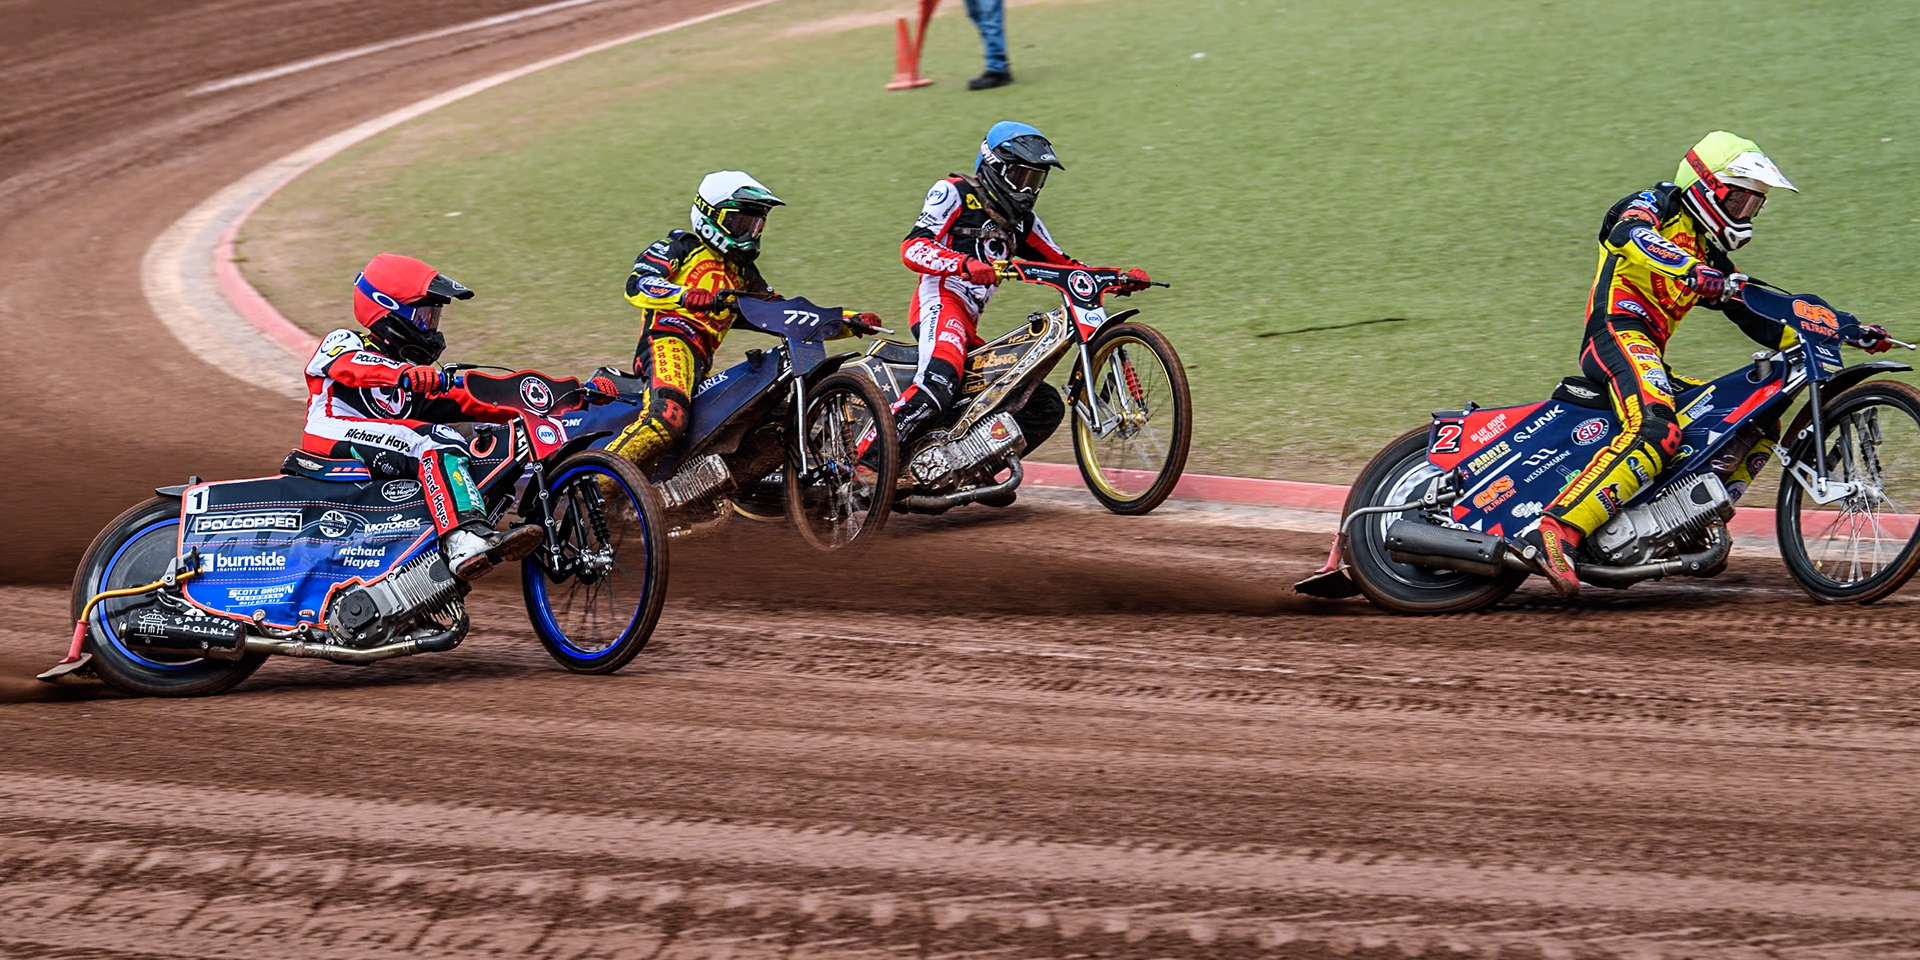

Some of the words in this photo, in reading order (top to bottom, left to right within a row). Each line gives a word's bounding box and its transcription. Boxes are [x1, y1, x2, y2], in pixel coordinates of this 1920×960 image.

[783, 310, 820, 326] 777
[1470, 426, 1488, 442] BLUE
[1487, 413, 1507, 429] DOOR
[1525, 404, 1564, 434] LINK
[1433, 425, 1462, 450] 2
[1478, 422, 1507, 444] PROJECT
[1581, 424, 1598, 439] STS
[1467, 441, 1509, 472] PARRYS
[1524, 450, 1572, 483] WESSEXMARINE
[1558, 452, 1617, 507] BRUMMIES
[422, 456, 440, 495] Ricard
[432, 493, 449, 528] Hayes
[194, 492, 203, 510] 1
[1483, 488, 1517, 514] FILTRATION
[200, 517, 296, 530] POLCOPPER
[364, 518, 421, 532] MOTOREX
[216, 551, 286, 567] burnside
[339, 546, 386, 556] Richard
[343, 557, 380, 569] Hayes
[228, 590, 258, 598] SCOTT
[261, 584, 294, 594] BROWN
[174, 616, 239, 631] EASTERN
[183, 625, 227, 636] POINT
